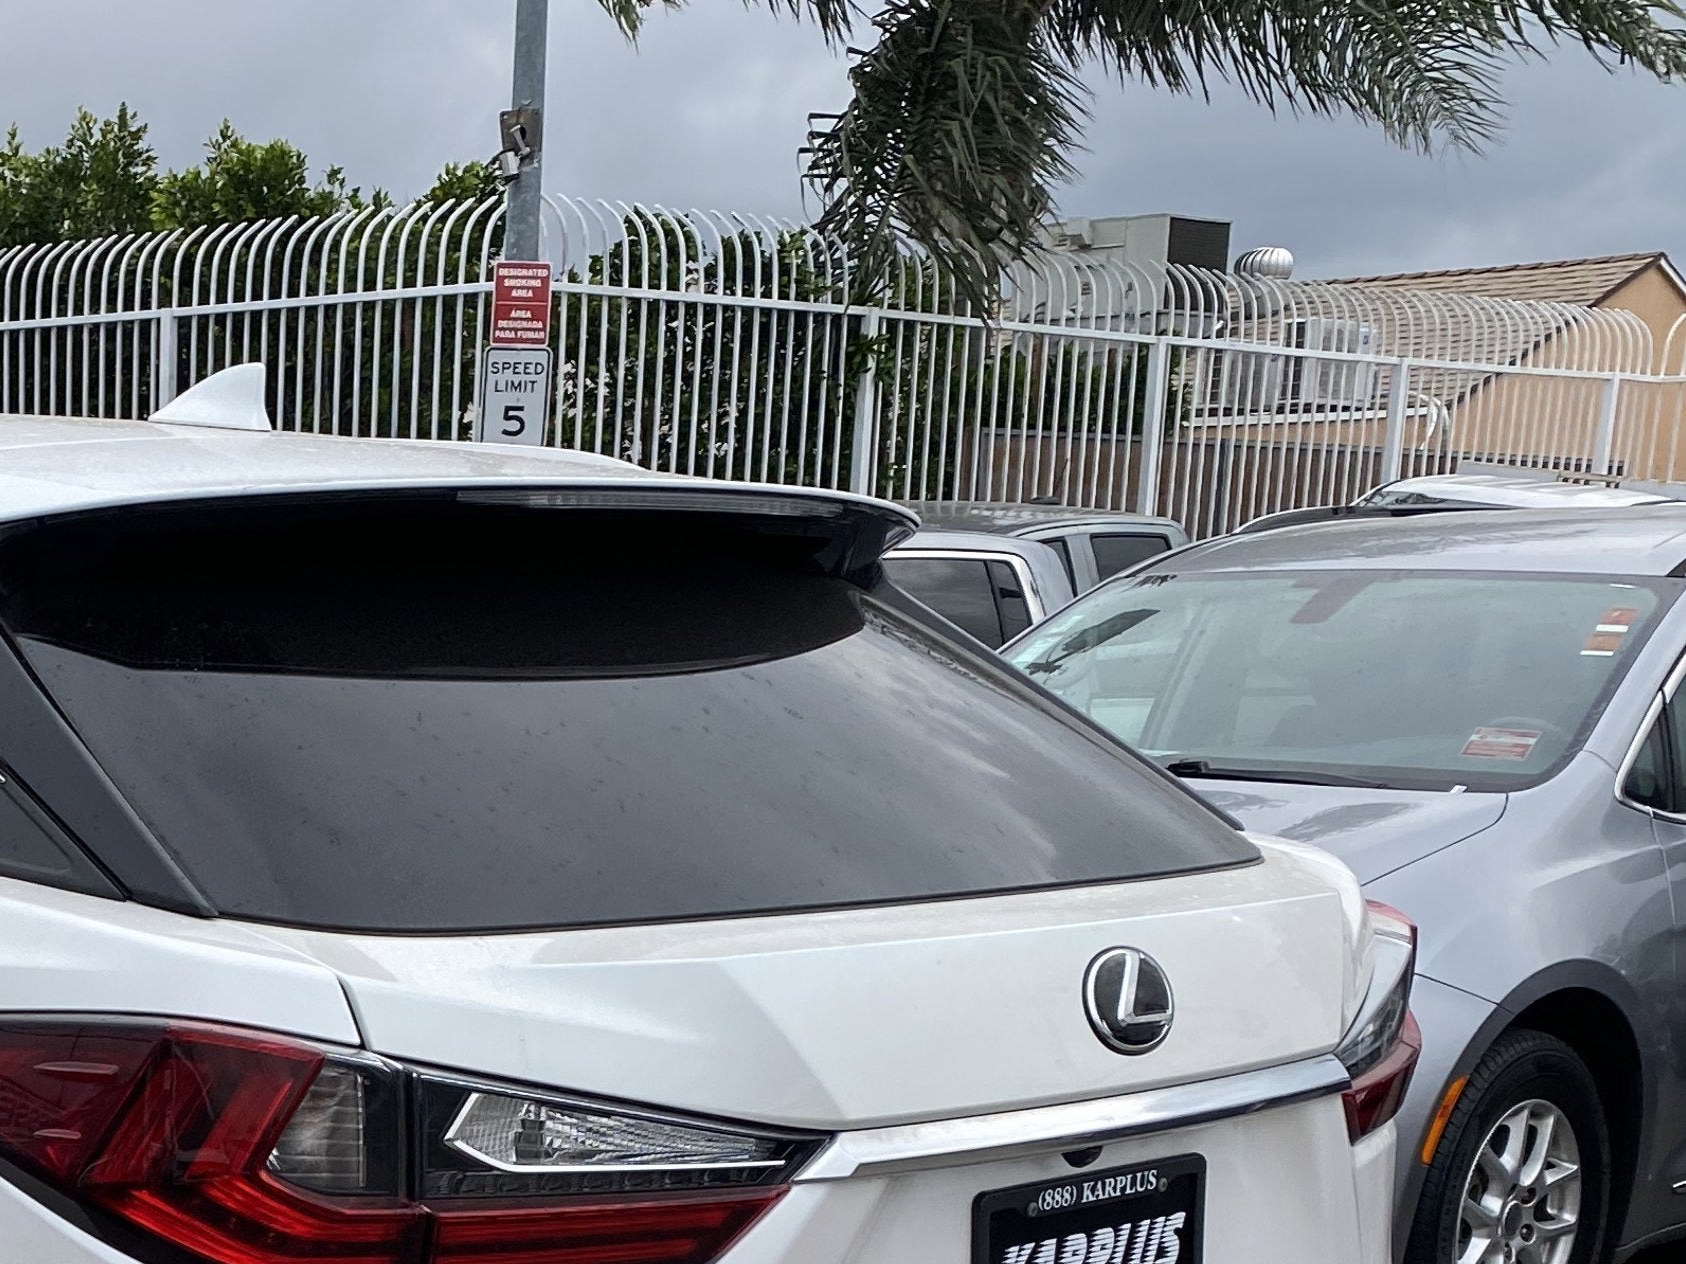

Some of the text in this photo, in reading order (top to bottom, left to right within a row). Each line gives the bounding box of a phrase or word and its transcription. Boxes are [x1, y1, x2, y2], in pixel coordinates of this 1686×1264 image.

[498, 267, 549, 278] DESIGNATED
[503, 278, 542, 288] SMOKING
[510, 289, 534, 298] AREA
[497, 320, 543, 330] DESIGNADA
[495, 330, 545, 340] PARA FUMAR
[491, 362, 544, 375] SPEED
[494, 380, 537, 393] LIMIT
[501, 405, 525, 436] 5
[1038, 1169, 1157, 1211] (888) KARPLUS
